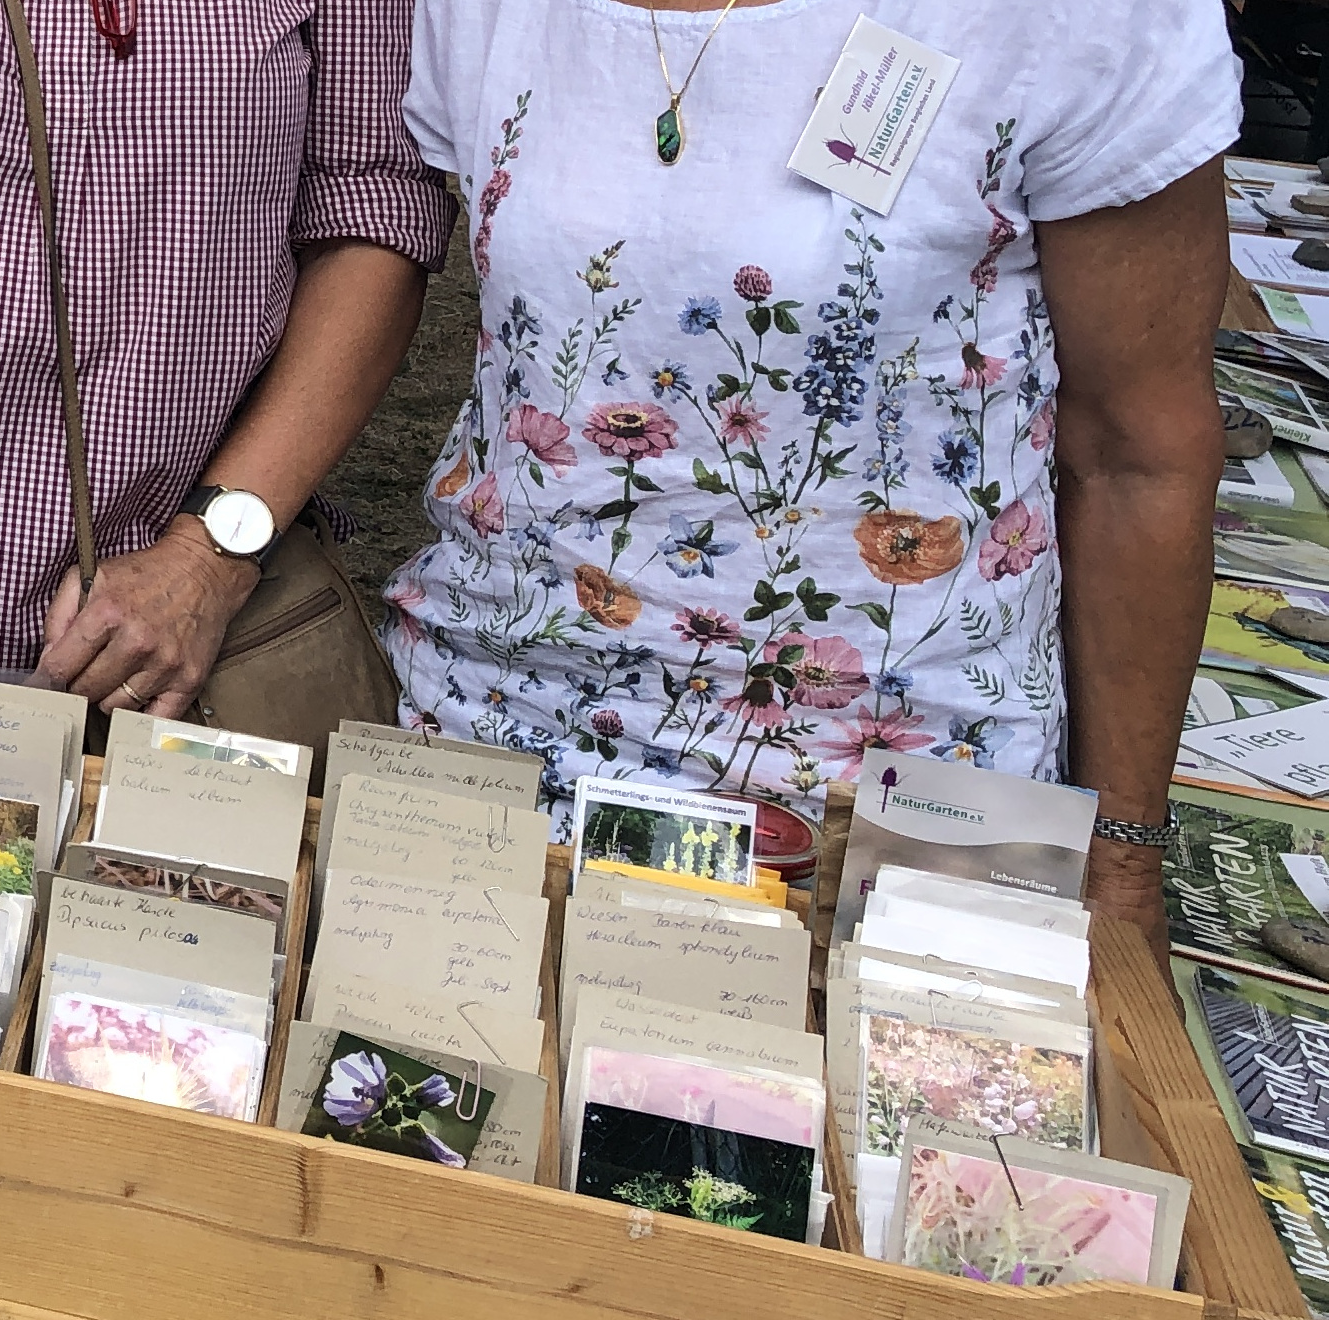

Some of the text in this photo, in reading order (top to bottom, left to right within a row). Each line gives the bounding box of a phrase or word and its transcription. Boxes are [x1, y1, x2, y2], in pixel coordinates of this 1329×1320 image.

[842, 69, 869, 115] Gundhild
[861, 46, 899, 113] Jäkel-Müller
[867, 80, 916, 160] NaturGarten
[889, 123, 916, 168] Regionalgruppe
[925, 78, 937, 95] Land
[586, 783, 748, 817] Schmetterlings- und Wildbienensaum
[891, 793, 968, 820] NaturGarten
[990, 870, 1058, 894] Lebensräume
[1171, 877, 1239, 952] NATUR
[1208, 832, 1272, 930] GARTEN
[1253, 1053, 1329, 1140] NATUR
[1271, 1201, 1329, 1282] Natur
